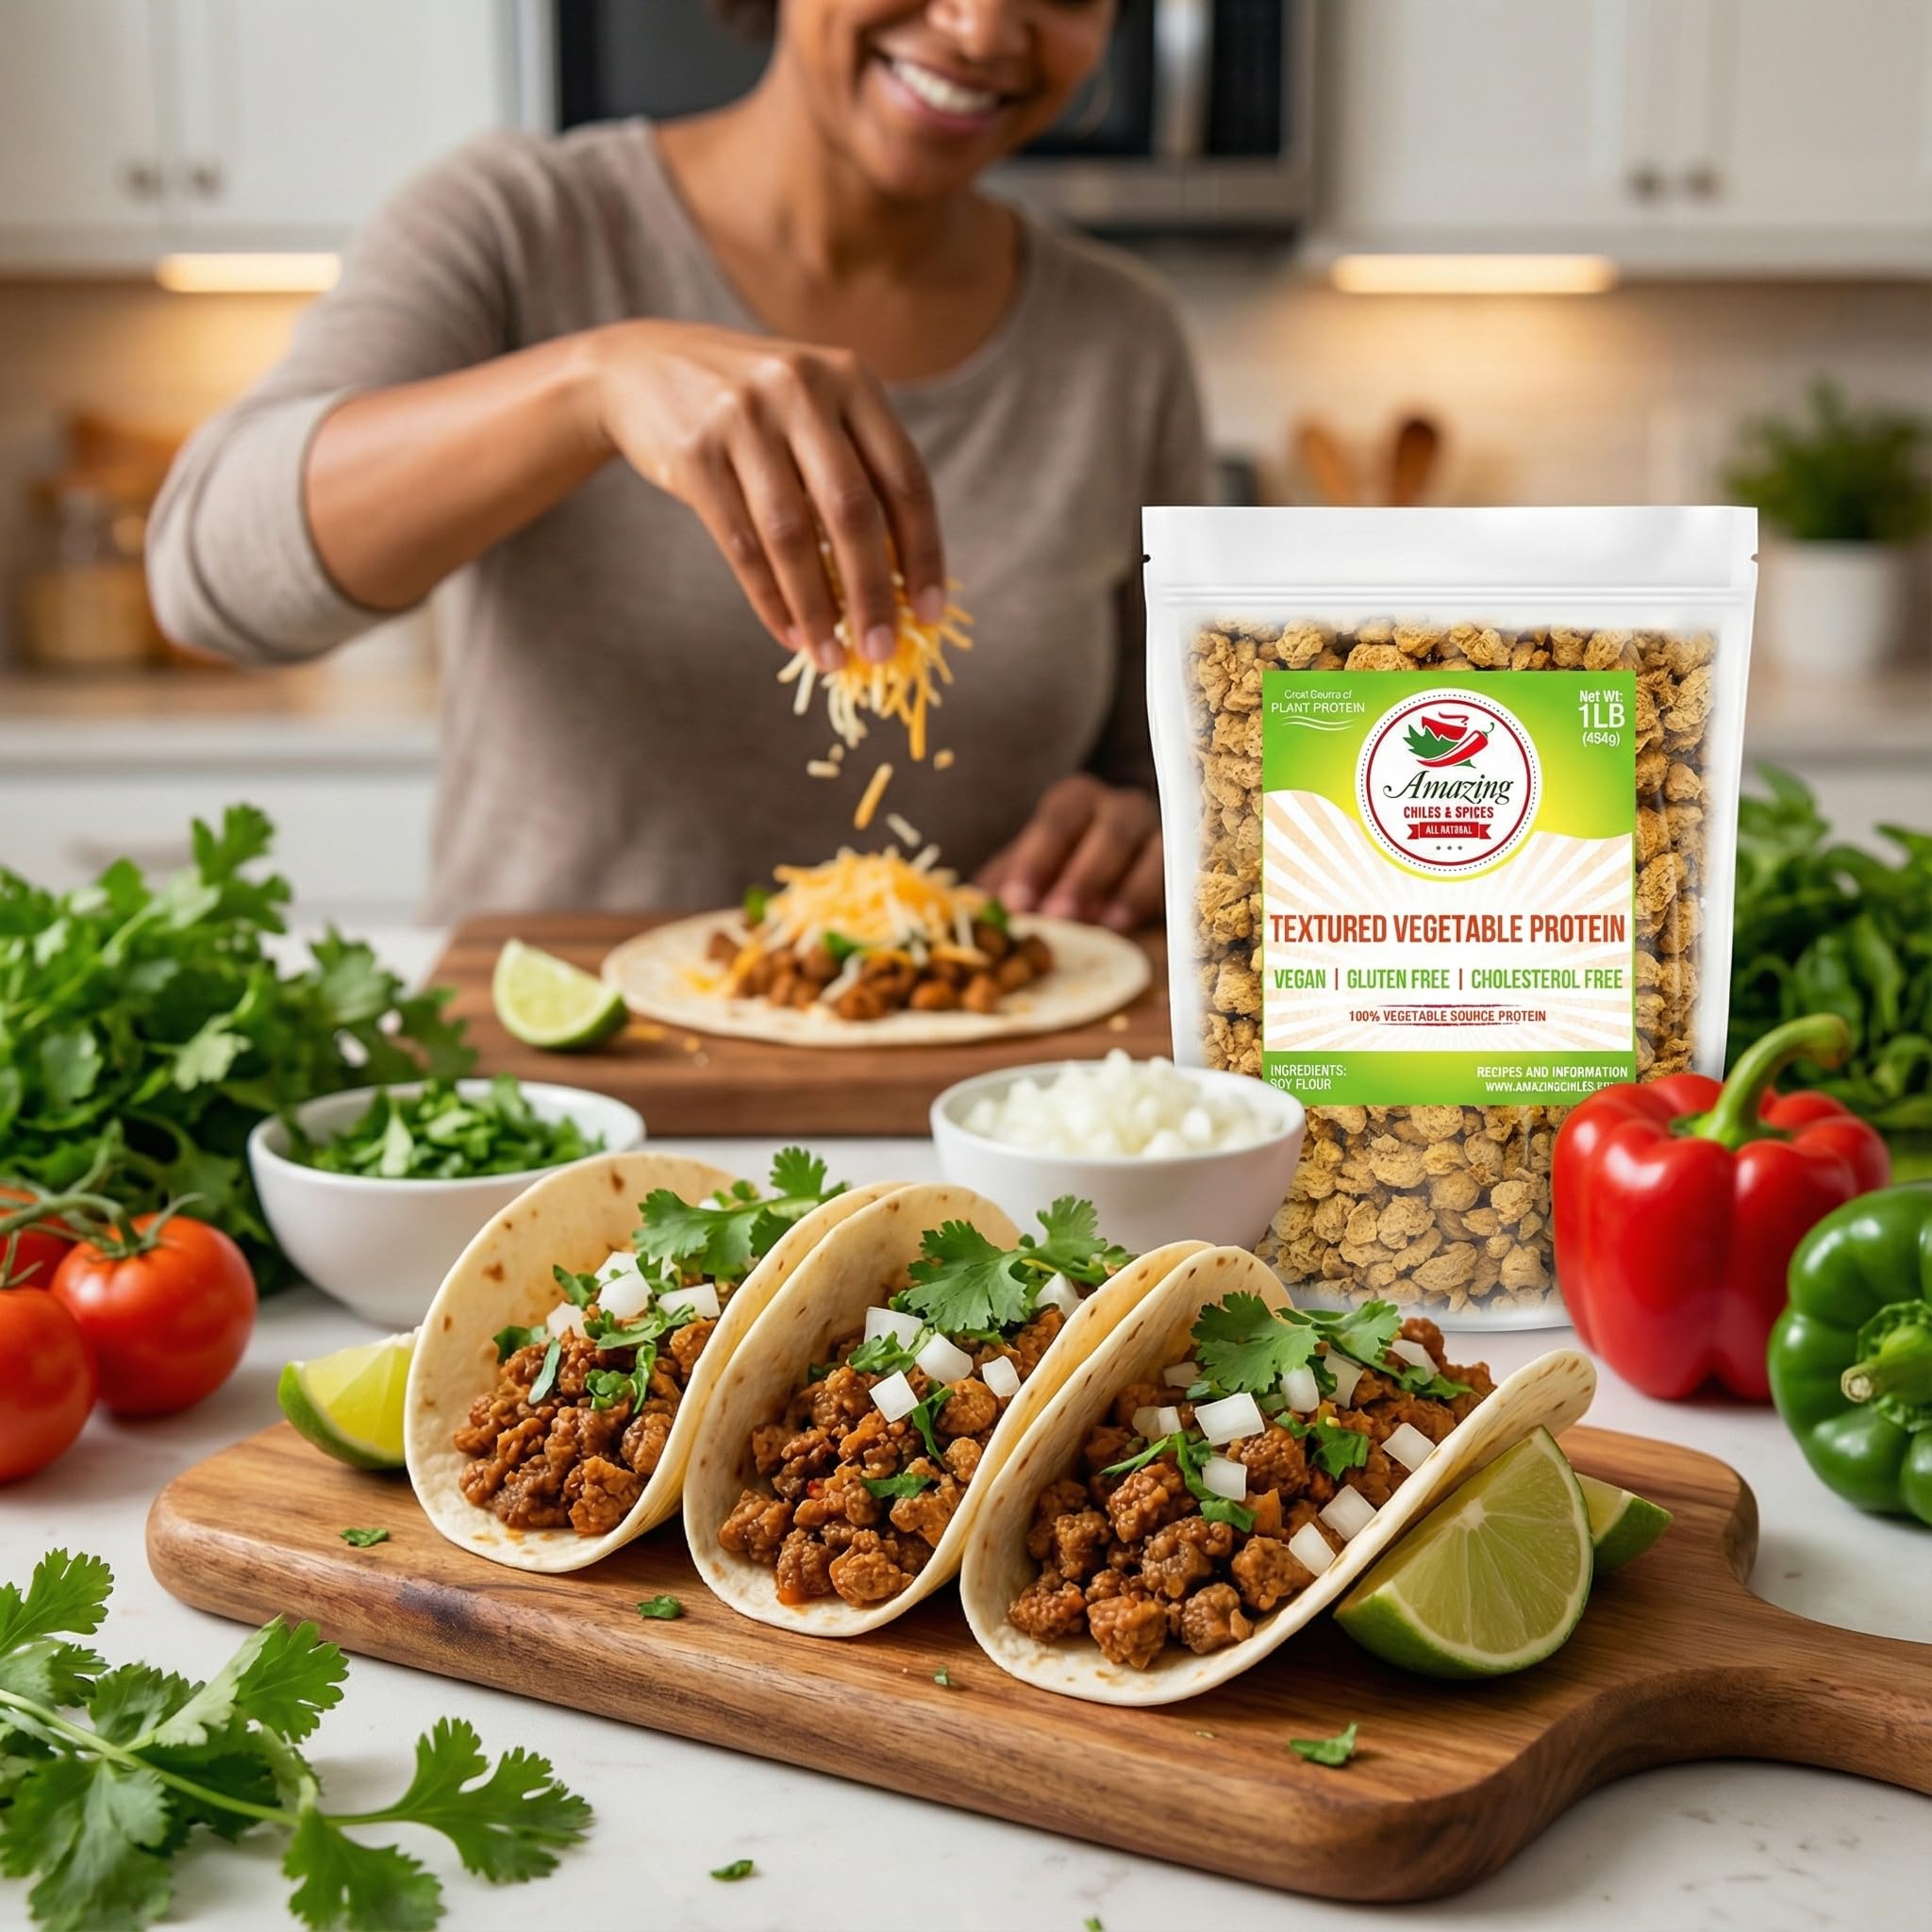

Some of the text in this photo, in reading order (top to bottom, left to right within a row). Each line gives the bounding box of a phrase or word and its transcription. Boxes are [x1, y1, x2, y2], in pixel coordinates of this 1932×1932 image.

[1579, 690, 1623, 703] Net Wt:
[1271, 702, 1365, 713] PLANT PROTEIN
[1578, 703, 1625, 728] 1LB
[1382, 770, 1514, 805] Amazing
[1404, 807, 1441, 819] CHILES
[1455, 807, 1494, 819] SPICES
[1425, 824, 1440, 835] ALL
[1270, 915, 1624, 942] TEXTURED VEGETABLE PROTEIN
[1274, 969, 1623, 990] VEGAN GLUTEN FREE CHOLESTEROL FREE
[1349, 1010, 1546, 1022] 100% VEGETABLE SOURCE PROTEIN
[1271, 1064, 1347, 1076] INGREDIENTS:
[1477, 1067, 1628, 1077] RECIPES AND INFORMATION
[1270, 1078, 1332, 1090] SOY FLOUR
